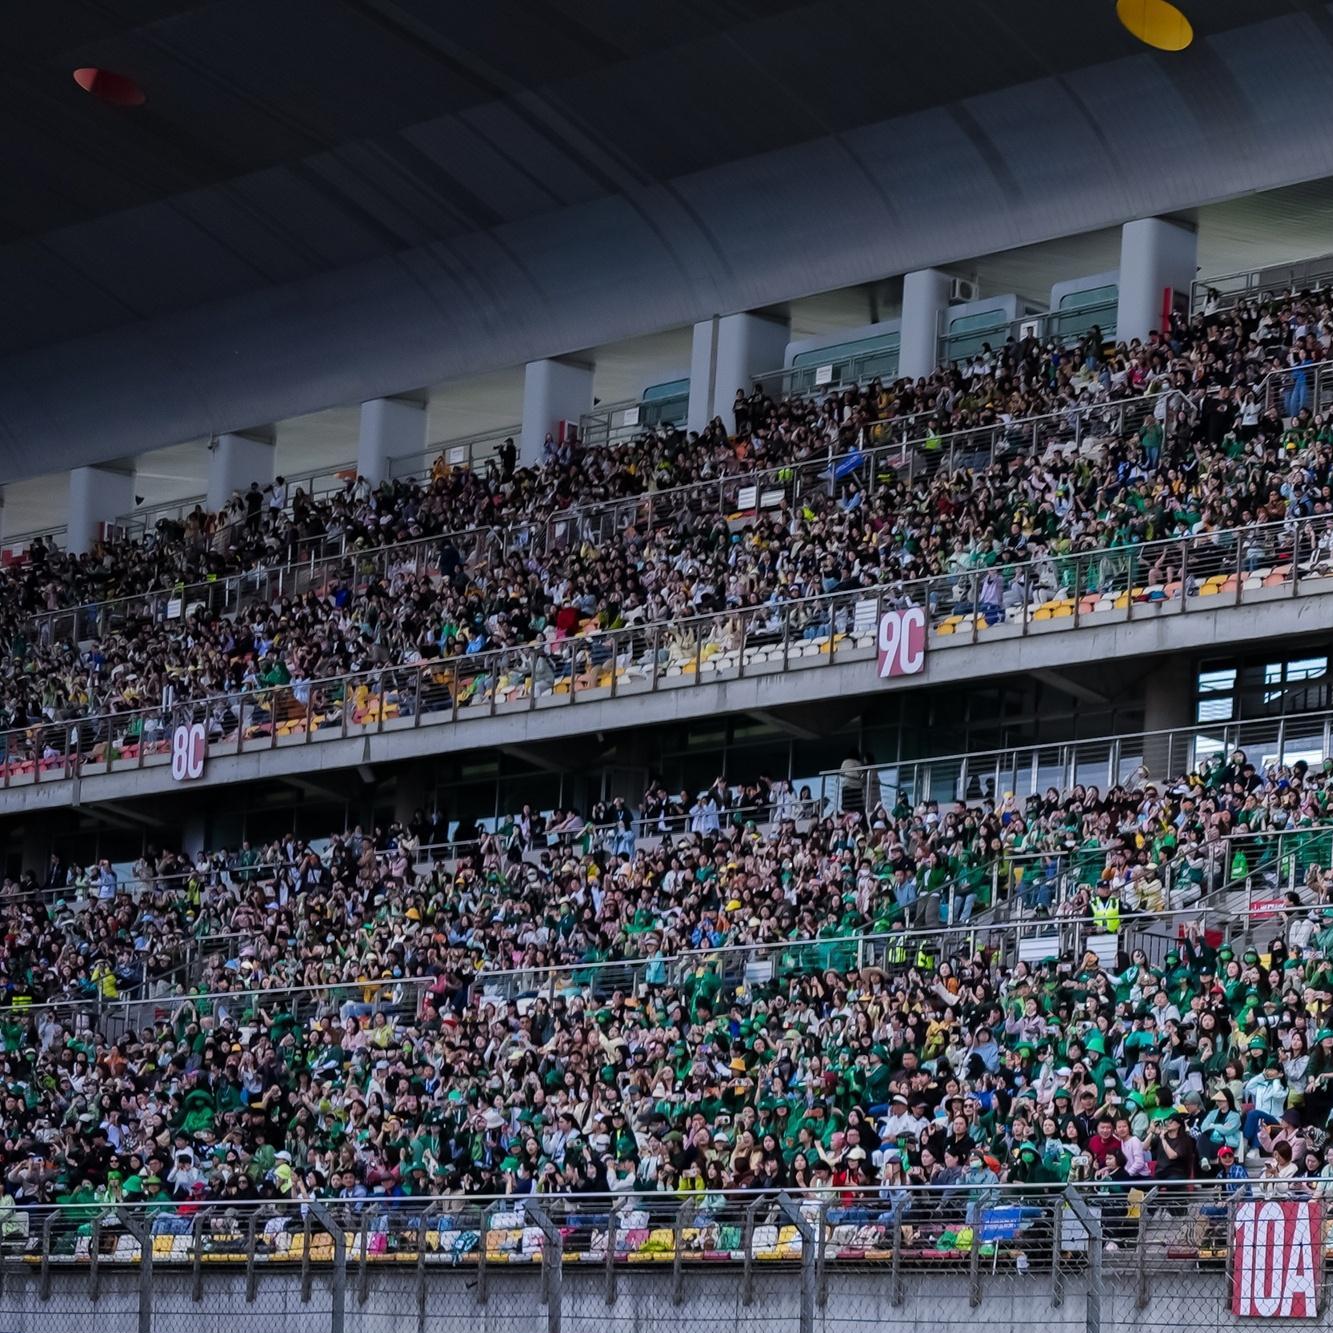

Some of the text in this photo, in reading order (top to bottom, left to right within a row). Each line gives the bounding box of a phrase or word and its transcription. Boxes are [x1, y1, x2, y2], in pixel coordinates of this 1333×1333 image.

[880, 608, 924, 677] 9C
[172, 723, 205, 780] 8C
[1234, 1201, 1317, 1317] 10A
